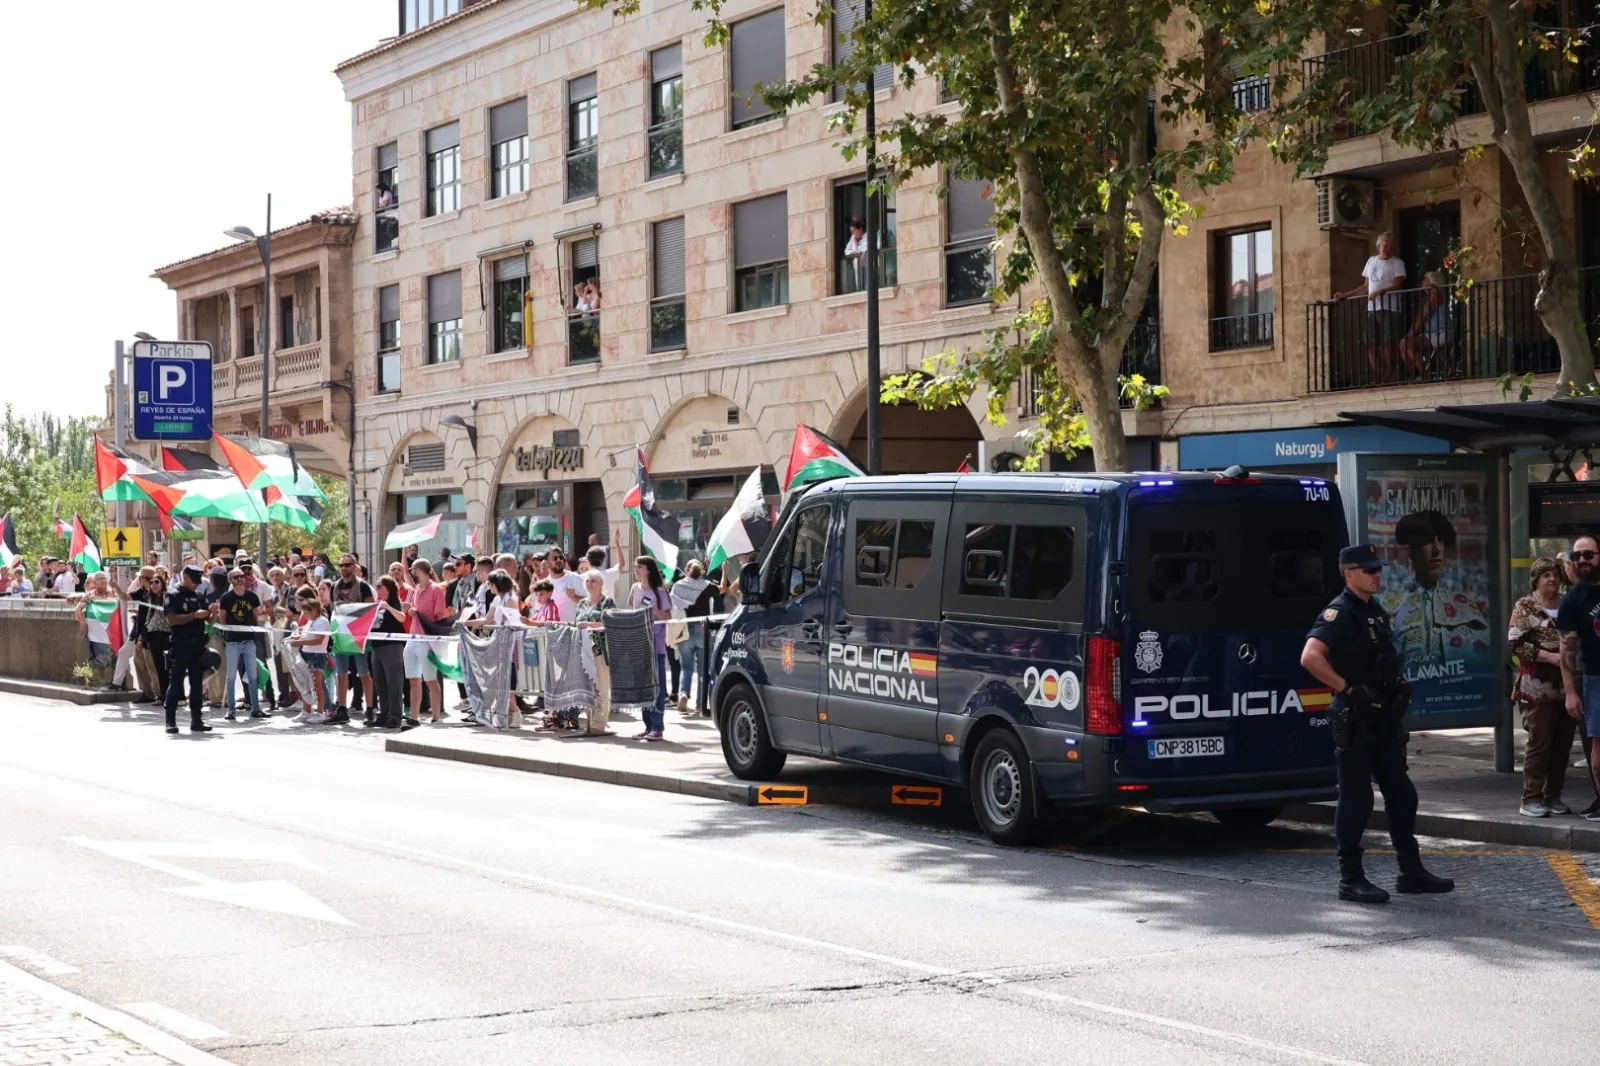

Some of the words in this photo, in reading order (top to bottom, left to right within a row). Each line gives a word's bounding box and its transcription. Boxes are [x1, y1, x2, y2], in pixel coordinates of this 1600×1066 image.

[150, 343, 194, 357] Parkia
[160, 365, 187, 399] P
[1275, 442, 1324, 458] Naturgy
[516, 445, 584, 480] telepizza
[1304, 487, 1330, 501] 7U-10
[1386, 488, 1467, 516] SALAMANCA
[735, 632, 745, 644] 091
[828, 668, 938, 705] NACIONAL
[1023, 666, 1080, 711] 200
[1156, 738, 1222, 756] CNP3815BC
